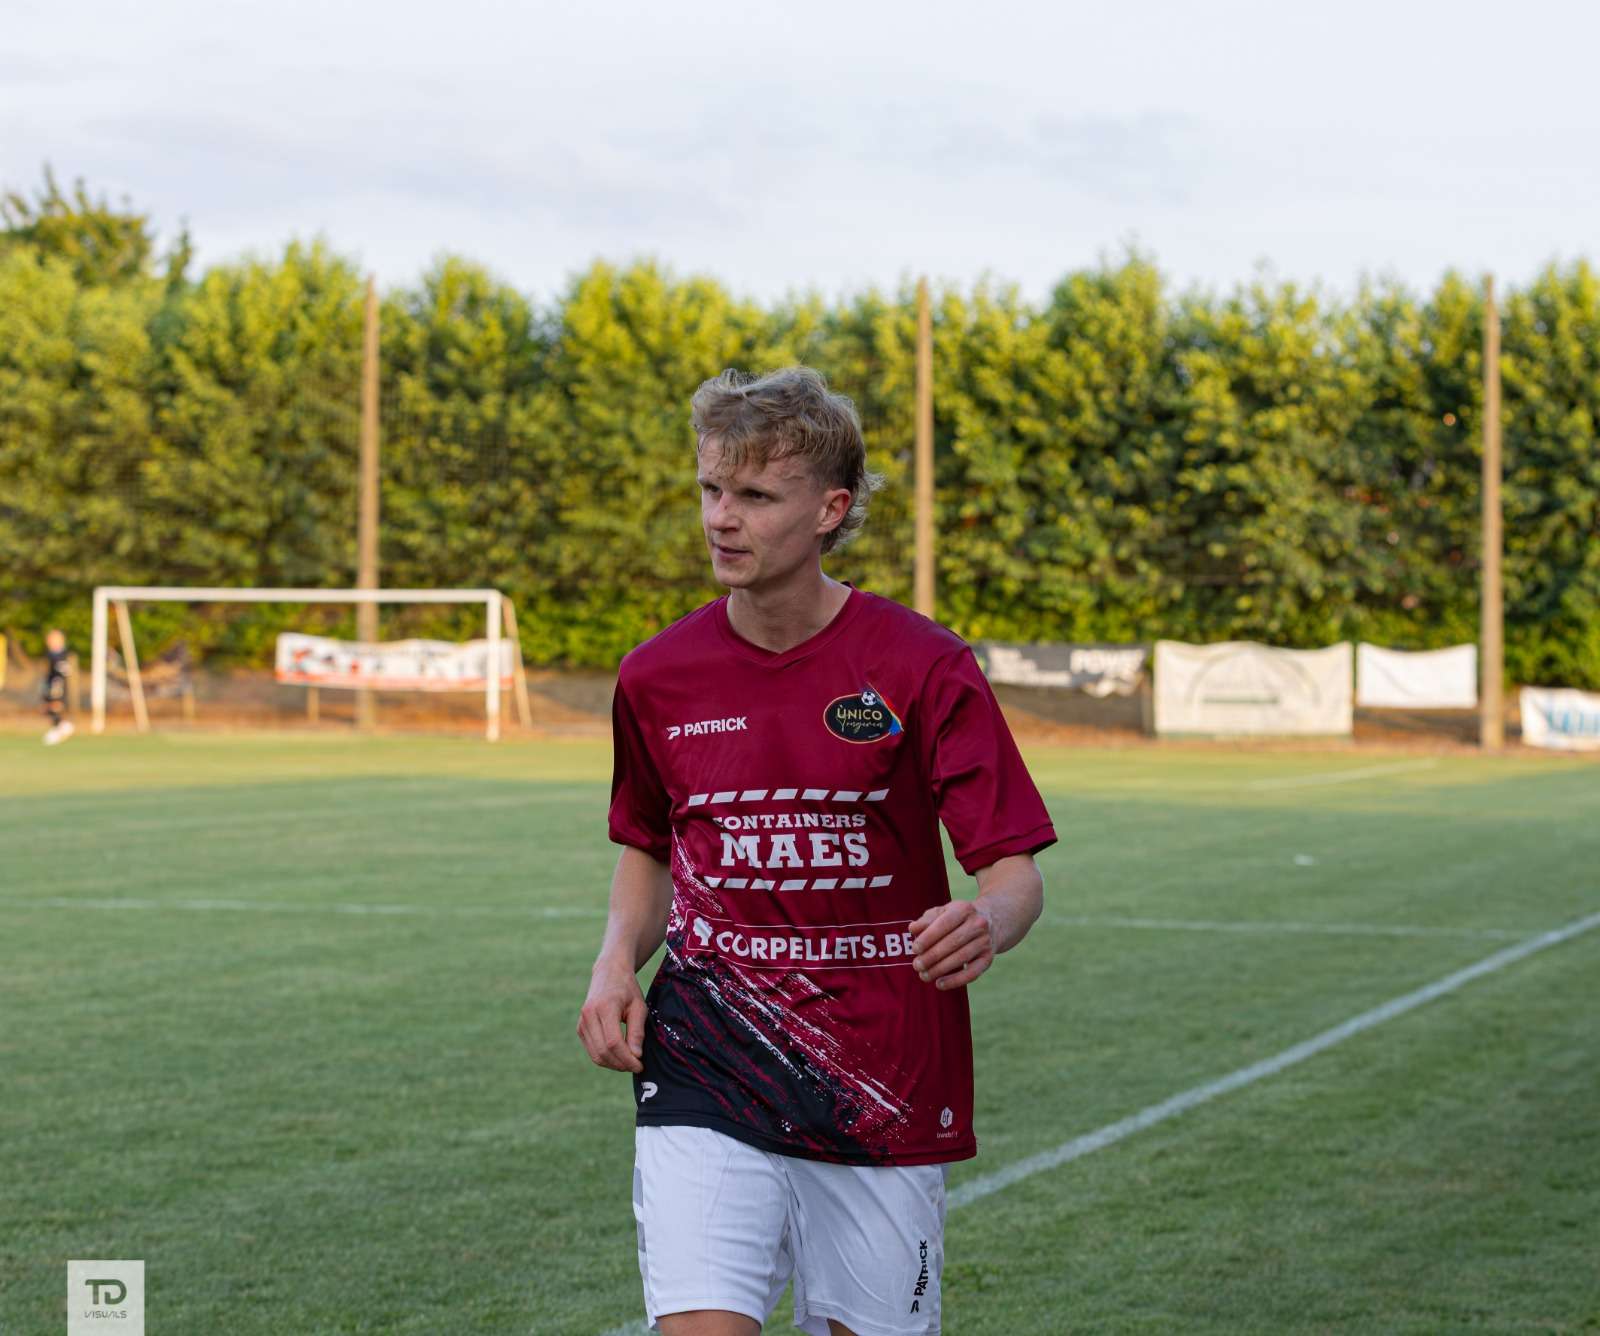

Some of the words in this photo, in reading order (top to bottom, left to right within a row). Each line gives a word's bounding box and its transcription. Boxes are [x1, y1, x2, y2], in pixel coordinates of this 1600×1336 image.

[684, 716, 748, 737] PATRICK
[720, 832, 870, 869] MAES
[716, 930, 913, 961] CORPELLETS.BE
